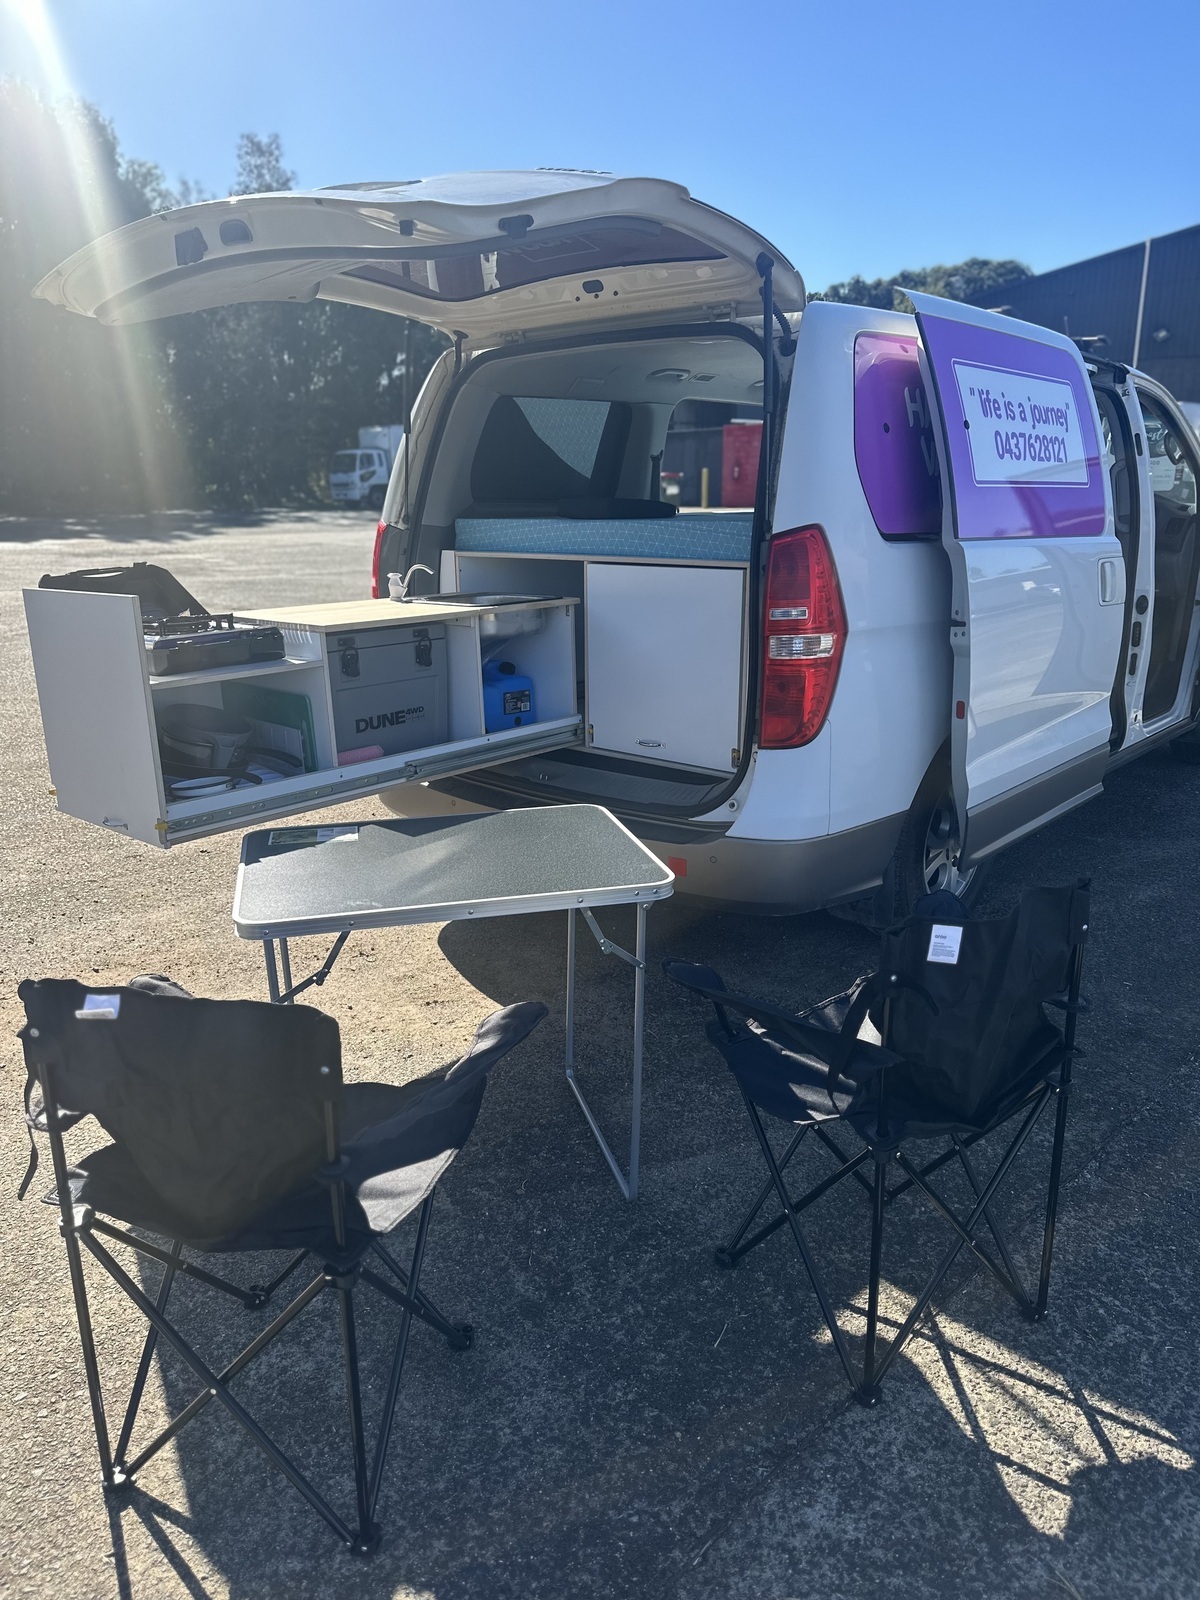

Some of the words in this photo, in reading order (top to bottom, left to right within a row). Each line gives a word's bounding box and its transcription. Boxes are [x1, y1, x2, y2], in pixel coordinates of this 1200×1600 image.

[1001, 391, 1016, 421] is
[1017, 402, 1028, 422] a
[994, 430, 1068, 463] 0437628121
[355, 709, 406, 734] DUNE
[405, 705, 425, 715] 4WD
